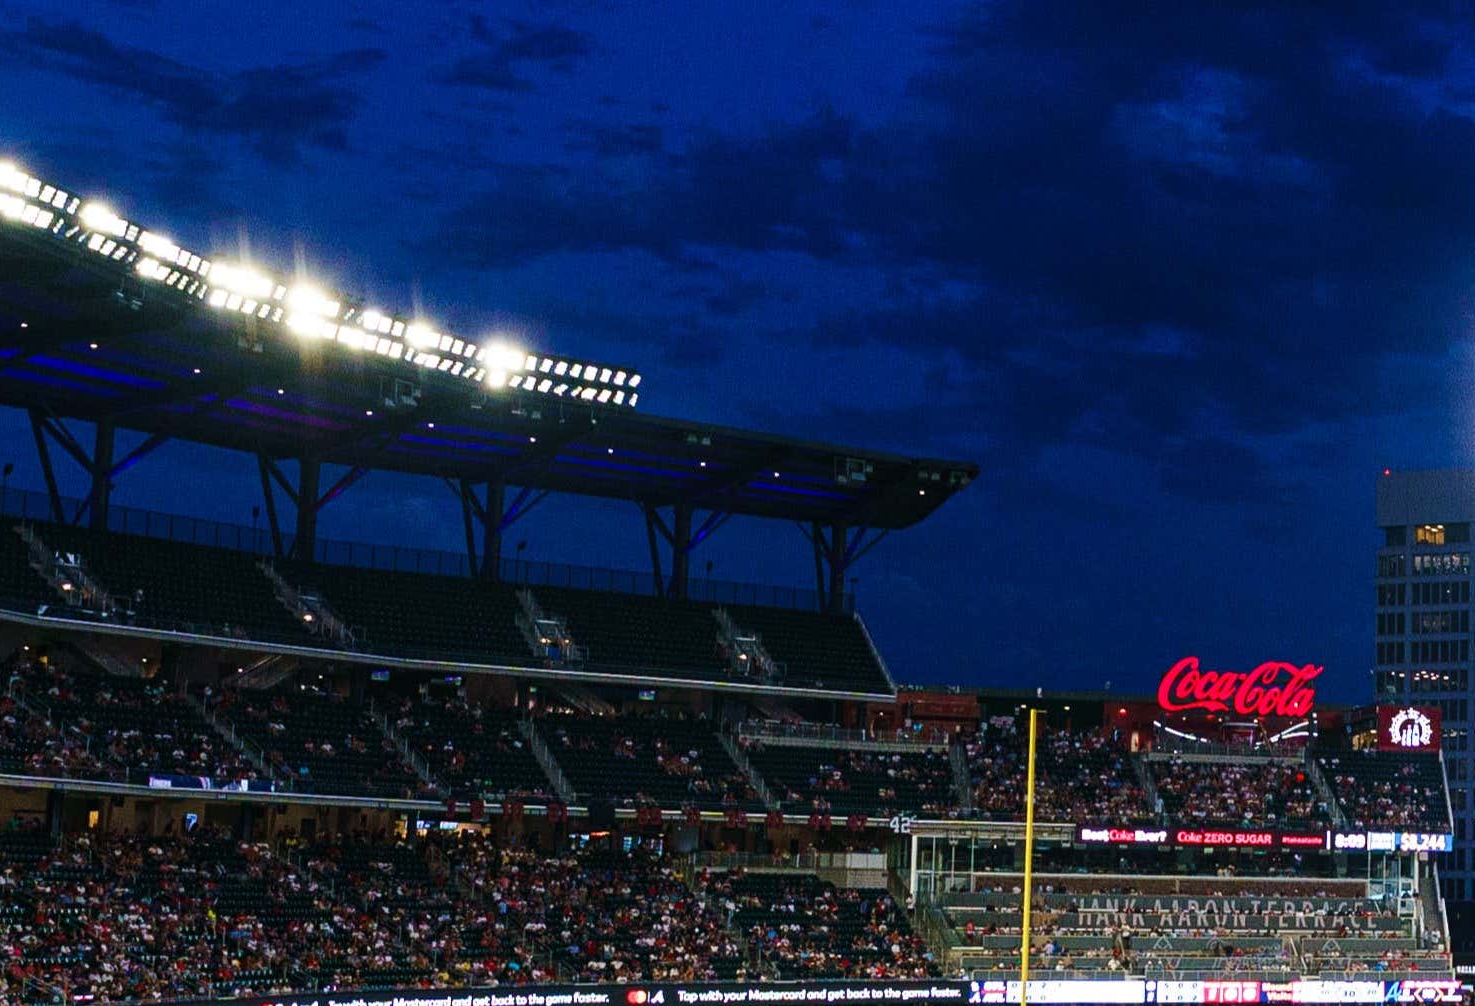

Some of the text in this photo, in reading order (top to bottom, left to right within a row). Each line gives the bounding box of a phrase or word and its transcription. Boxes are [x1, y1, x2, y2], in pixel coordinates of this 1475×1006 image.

[1158, 656, 1324, 717] Coca-Cola
[889, 815, 911, 834] 42
[1109, 829, 1135, 841] Coke
[1177, 831, 1272, 844] Coke ZERO SUGAR
[1153, 898, 1377, 929] AARON TERRACE
[678, 991, 697, 1003] Tap
[699, 990, 722, 1001] with
[724, 991, 747, 1003] your
[749, 989, 805, 1001] Mastercard
[807, 989, 826, 1000] and
[828, 990, 845, 1002] get
[847, 988, 870, 1000] back
[884, 988, 901, 998] the
[902, 989, 929, 1000] game
